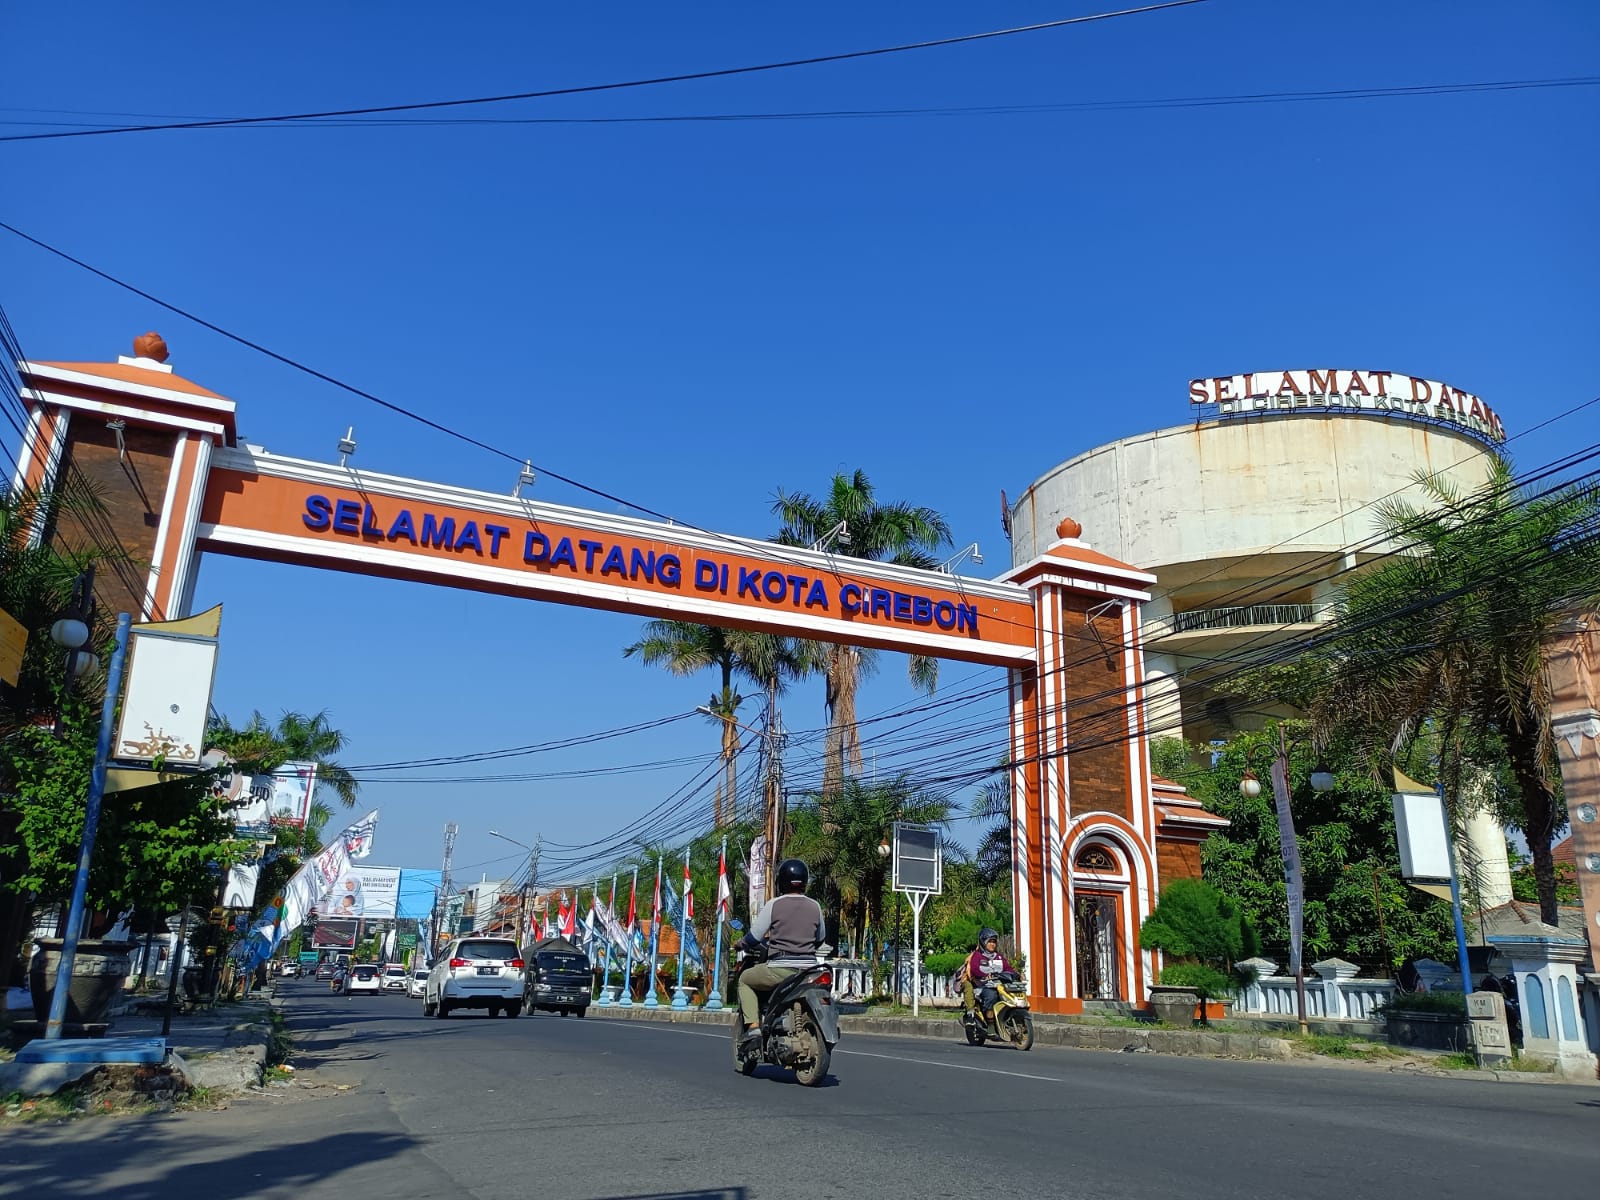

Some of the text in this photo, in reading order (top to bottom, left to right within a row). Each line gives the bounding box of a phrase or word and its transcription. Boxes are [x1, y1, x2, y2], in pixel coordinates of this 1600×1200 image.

[1189, 369, 1506, 441] SELAMAT DATANG
[1220, 398, 1242, 413] DI
[1253, 394, 1361, 410] CIREBON
[1373, 394, 1429, 416] KOTA
[302, 494, 978, 632] SELAMAT DATANG DI KOTA CIREBON
